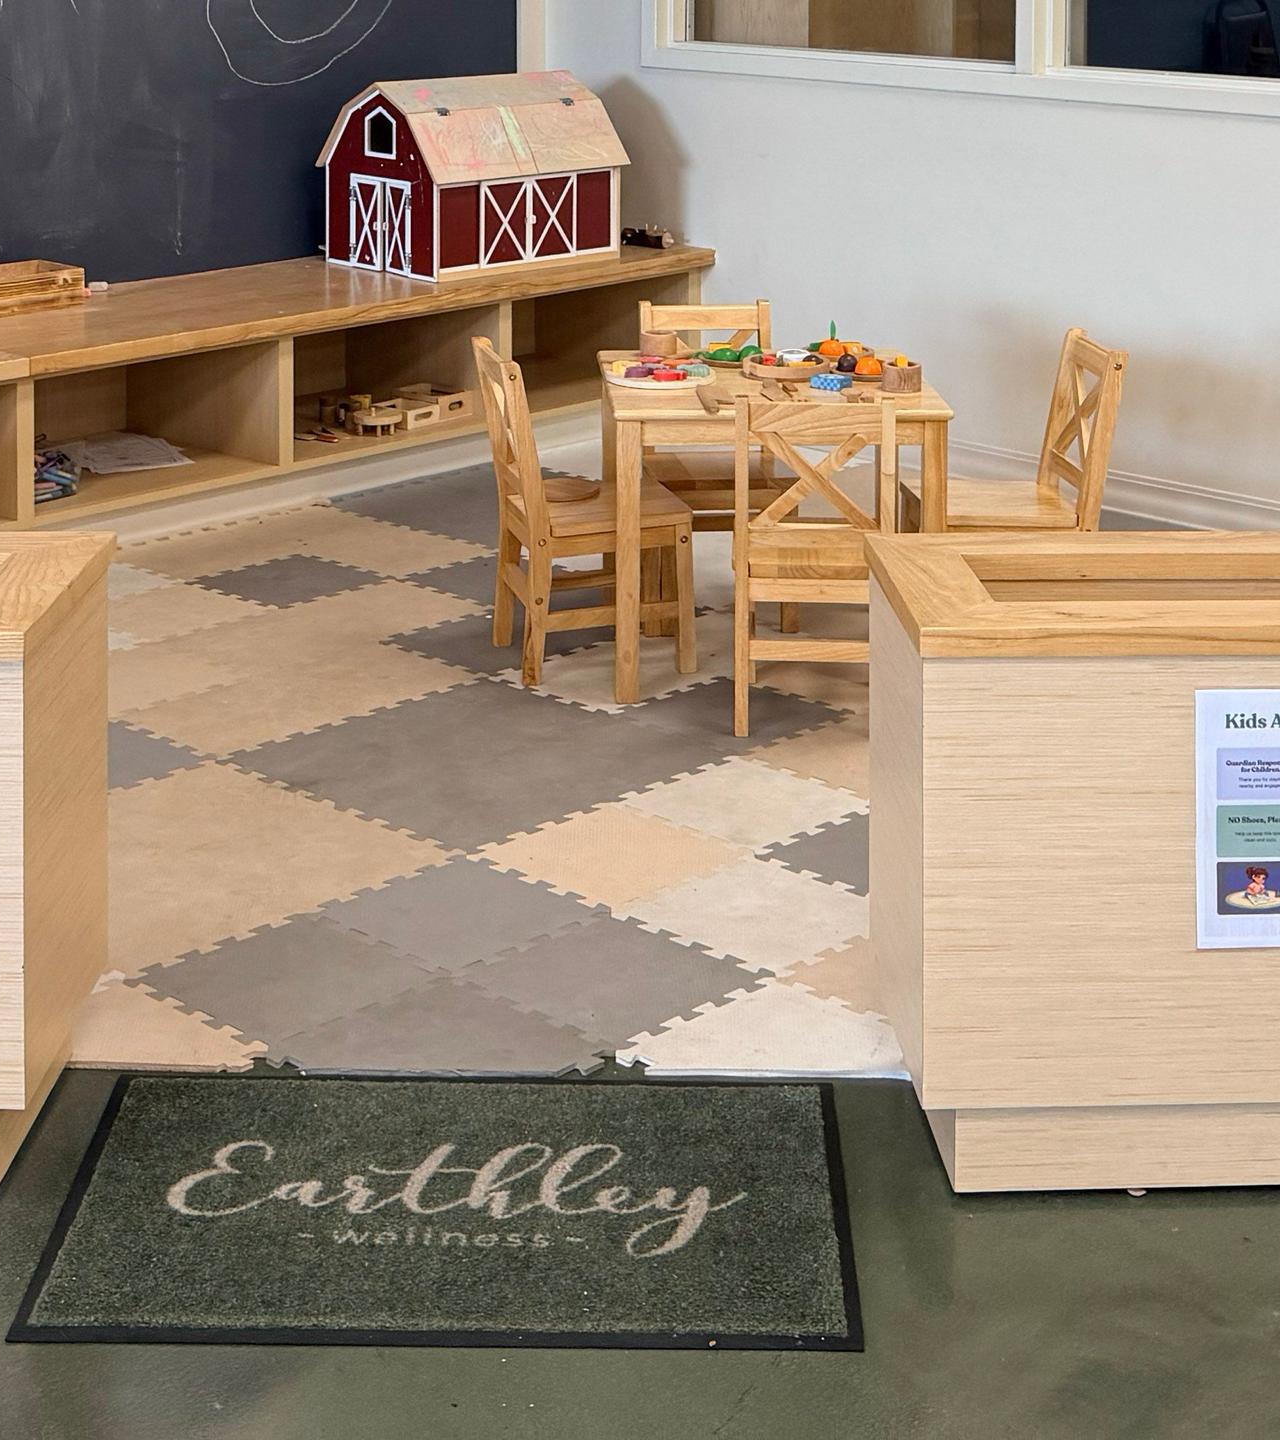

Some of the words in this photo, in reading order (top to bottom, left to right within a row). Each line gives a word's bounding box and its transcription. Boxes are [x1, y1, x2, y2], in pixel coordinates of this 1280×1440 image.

[1225, 713, 1267, 729] Kids
[166, 1140, 748, 1257] Earthley
[332, 1227, 556, 1248] wellness
